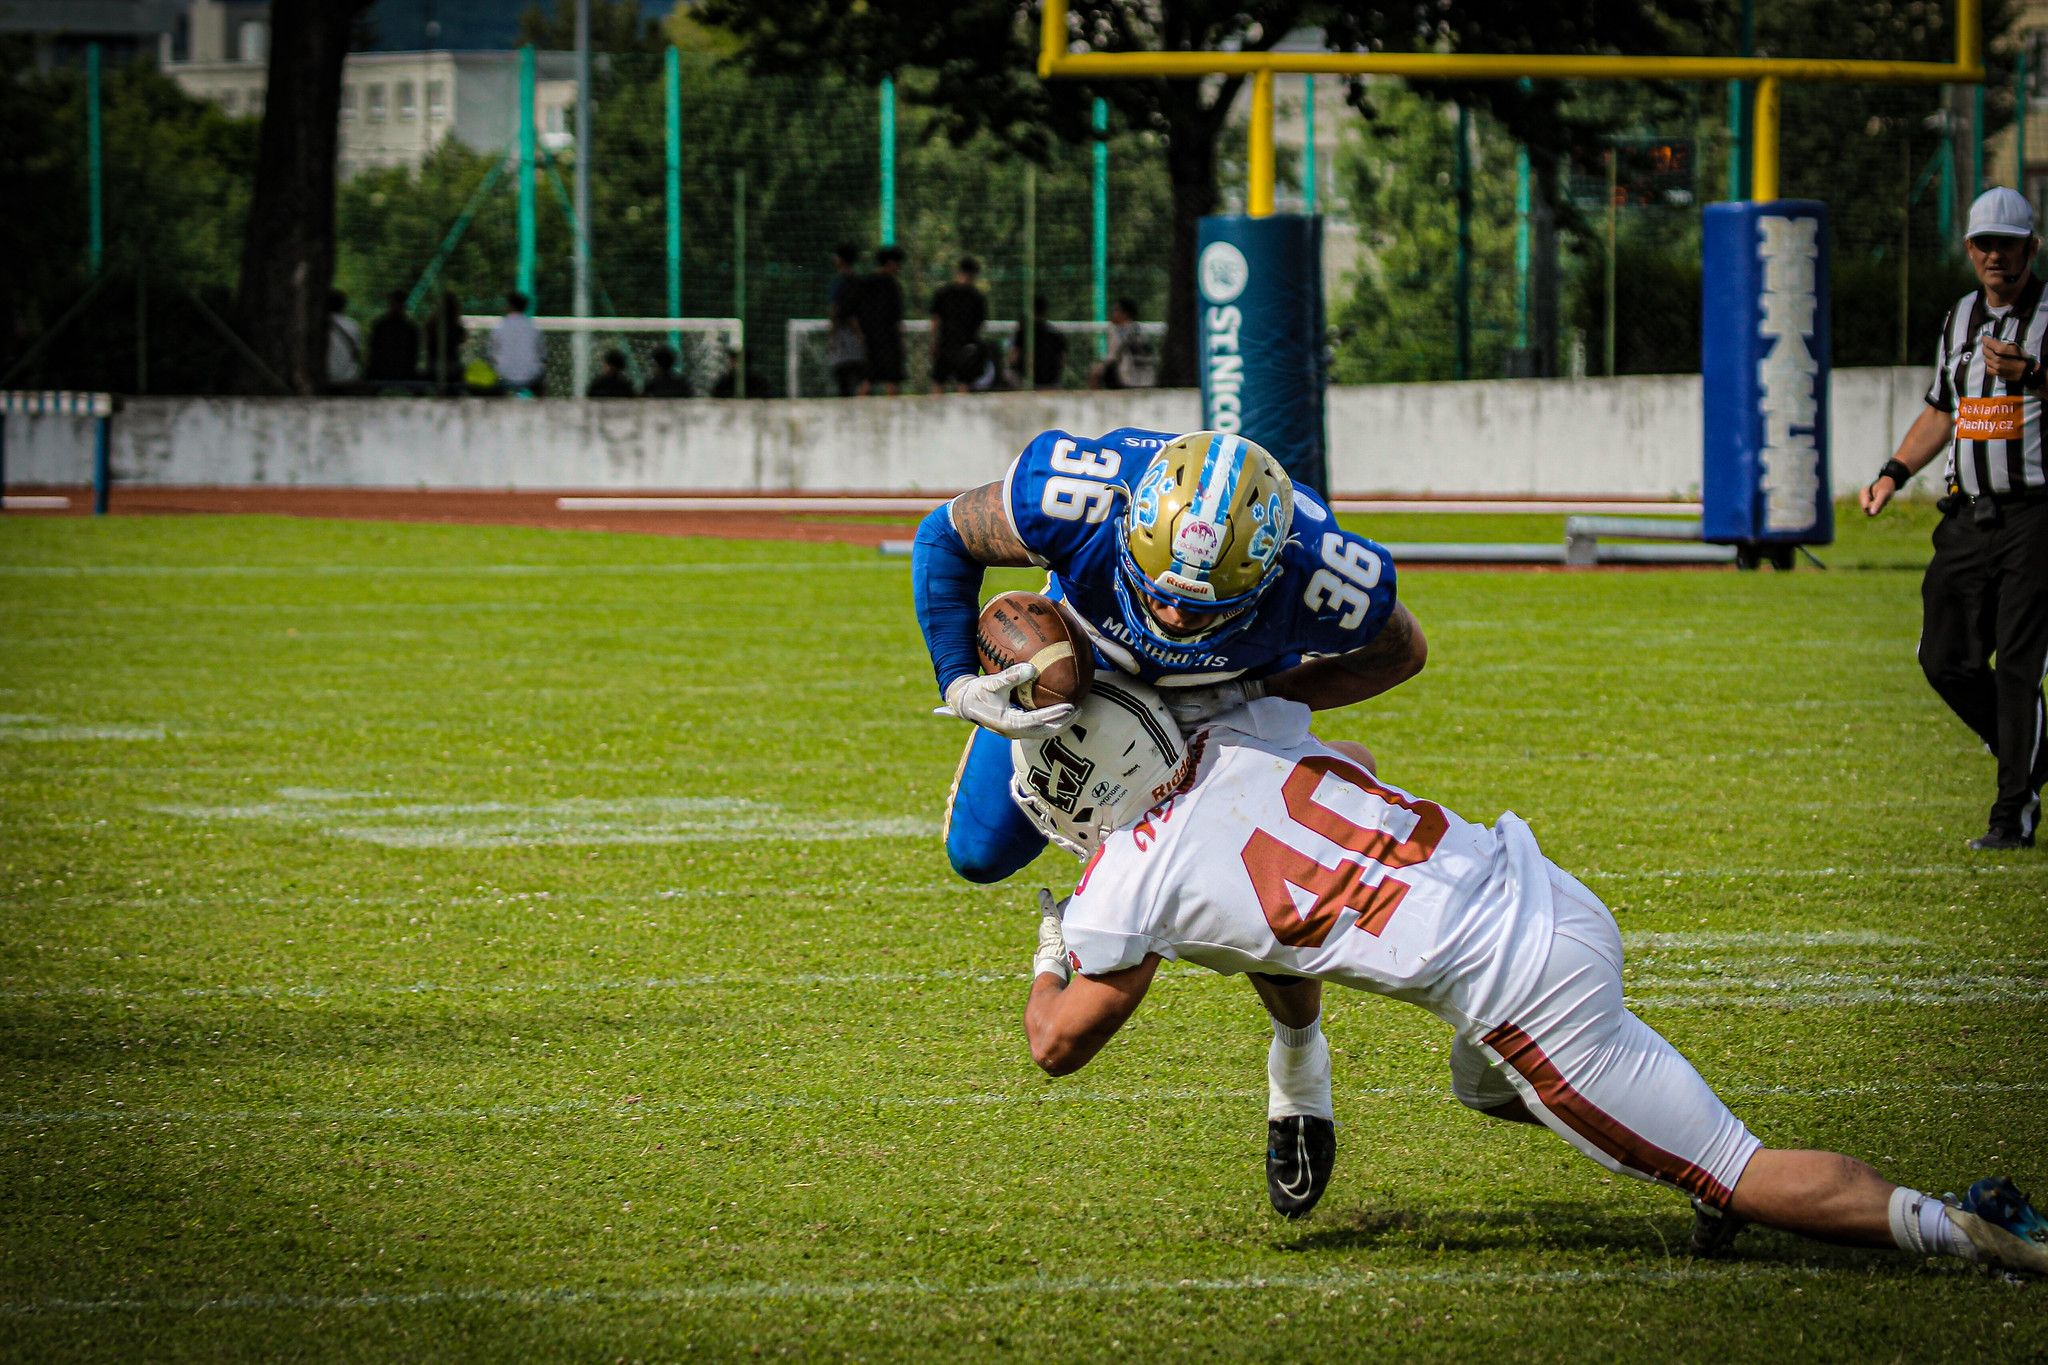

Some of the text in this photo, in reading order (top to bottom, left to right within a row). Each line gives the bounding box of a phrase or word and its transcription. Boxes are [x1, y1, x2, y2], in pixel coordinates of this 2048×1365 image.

[1042, 438, 1122, 524] 36
[1166, 575, 1208, 595] Riddell
[1304, 532, 1382, 630] 36
[1241, 755, 1450, 947] 40
